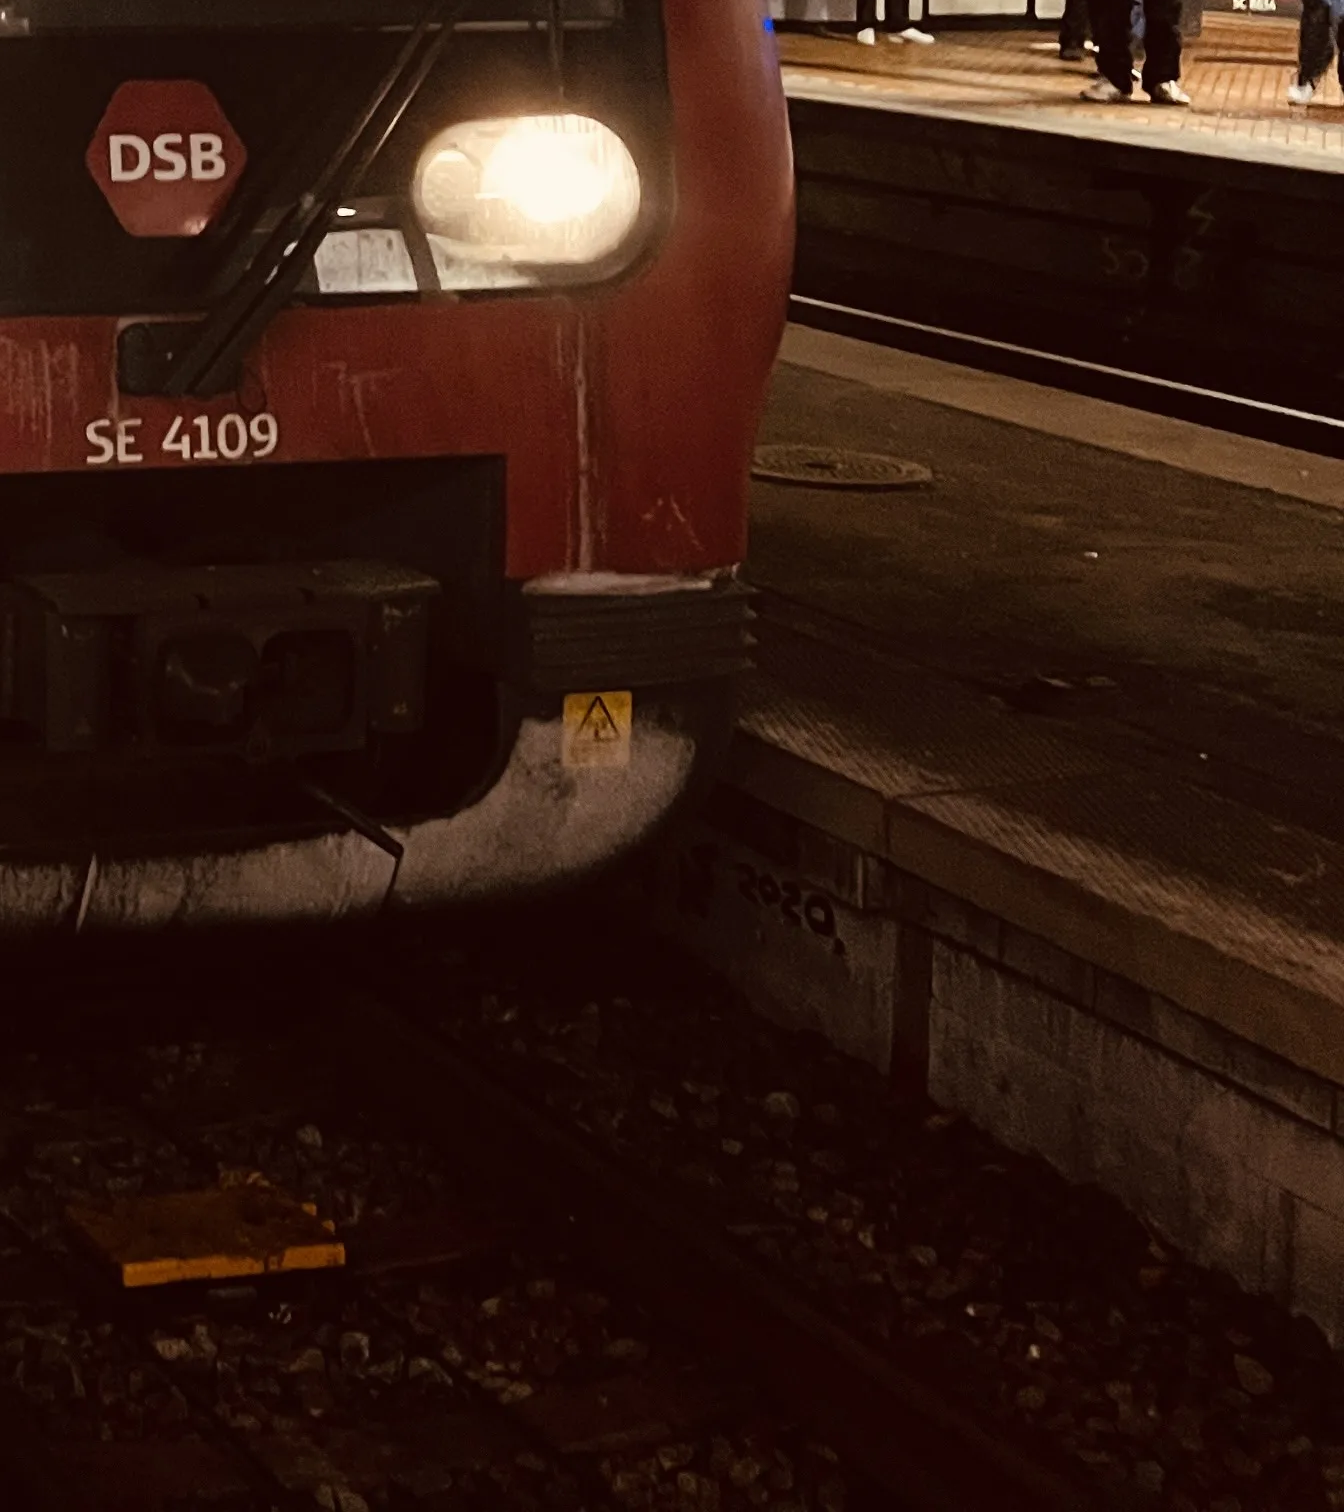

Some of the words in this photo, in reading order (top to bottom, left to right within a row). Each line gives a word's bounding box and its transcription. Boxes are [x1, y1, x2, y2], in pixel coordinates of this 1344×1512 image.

[109, 133, 226, 182] DSB
[86, 418, 143, 464] SE
[162, 413, 278, 460] 4109
